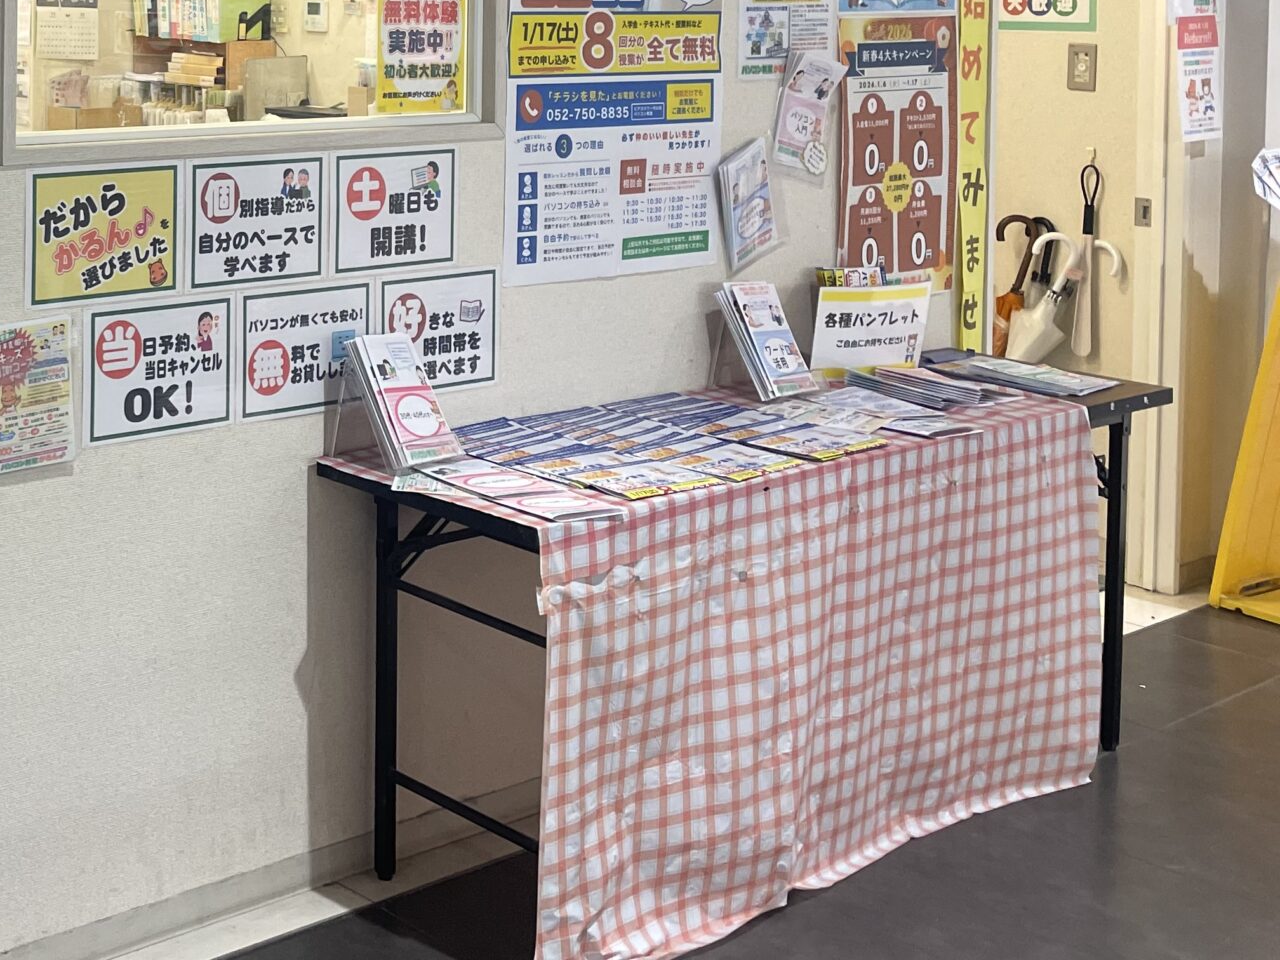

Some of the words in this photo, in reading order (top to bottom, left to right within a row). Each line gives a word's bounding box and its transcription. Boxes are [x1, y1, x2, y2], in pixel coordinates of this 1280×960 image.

[384, 0, 459, 25] 無料体験
[522, 22, 578, 44] 1/17(土)
[582, 11, 614, 69] 8
[647, 35, 716, 62] 全て無料
[862, 49, 933, 63] 新春4大キャンペーン
[546, 106, 629, 122] 052-750-8835
[38, 183, 126, 244] だから
[159, 217, 170, 230] を
[198, 226, 317, 256] 自分のペースで
[80, 237, 169, 291] 選びました
[223, 253, 292, 278] 学べます
[824, 308, 920, 329] 各種パンフレット
[423, 331, 481, 356] 時間帯を
[144, 352, 223, 381] 当日キャンセル
[422, 353, 482, 380] 選べます
